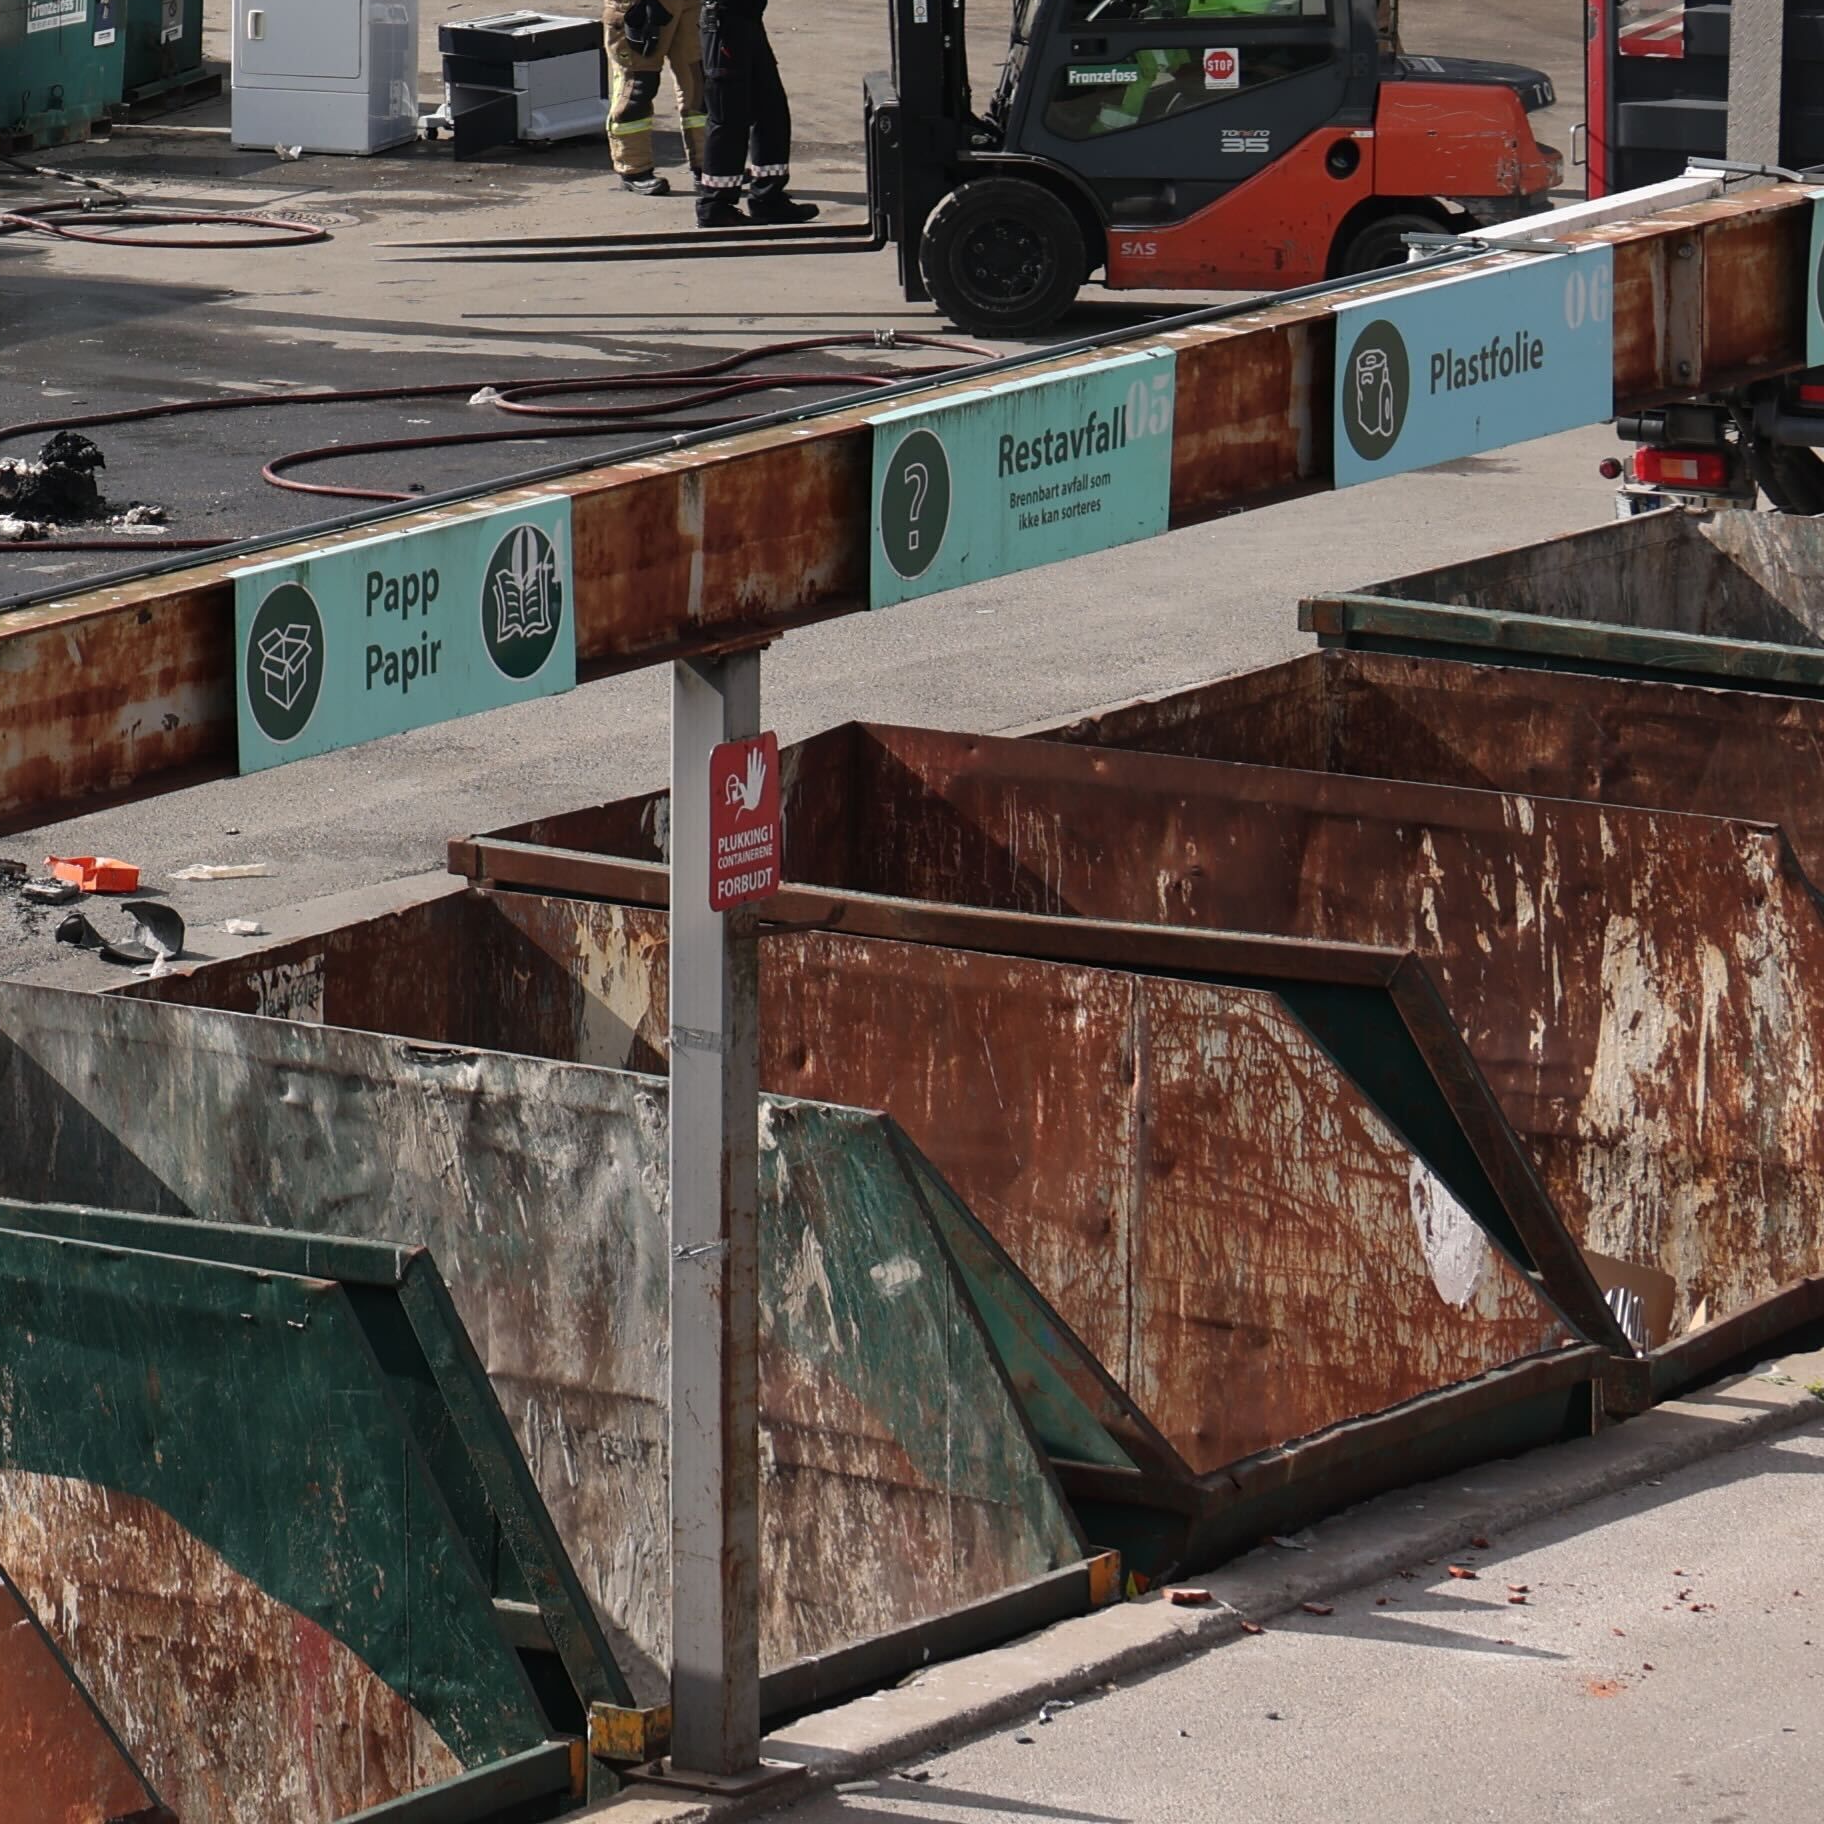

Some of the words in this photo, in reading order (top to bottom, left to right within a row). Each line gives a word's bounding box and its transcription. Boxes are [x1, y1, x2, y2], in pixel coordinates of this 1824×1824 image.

[1068, 70, 1138, 85] Franzefoss
[1207, 59, 1233, 72] STOP
[1220, 138, 1270, 153] 35
[1120, 241, 1158, 257] SAS
[1563, 260, 1609, 330] 06
[1430, 330, 1544, 396] Plastfolie
[1125, 371, 1171, 442] 05
[998, 405, 1127, 478] Restavfall
[1009, 482, 1058, 513] Brennbart
[1060, 475, 1088, 499] avfall
[1090, 473, 1111, 492] som
[1018, 509, 1039, 531] ikke
[1041, 508, 1059, 526] kan
[1060, 498, 1102, 523] sorteres
[364, 566, 440, 622] Papp
[364, 632, 442, 695] Papir
[717, 843, 774, 870] CONTAINERENE
[718, 825, 769, 855] PLUKKING
[717, 867, 774, 900] FORBUDT
